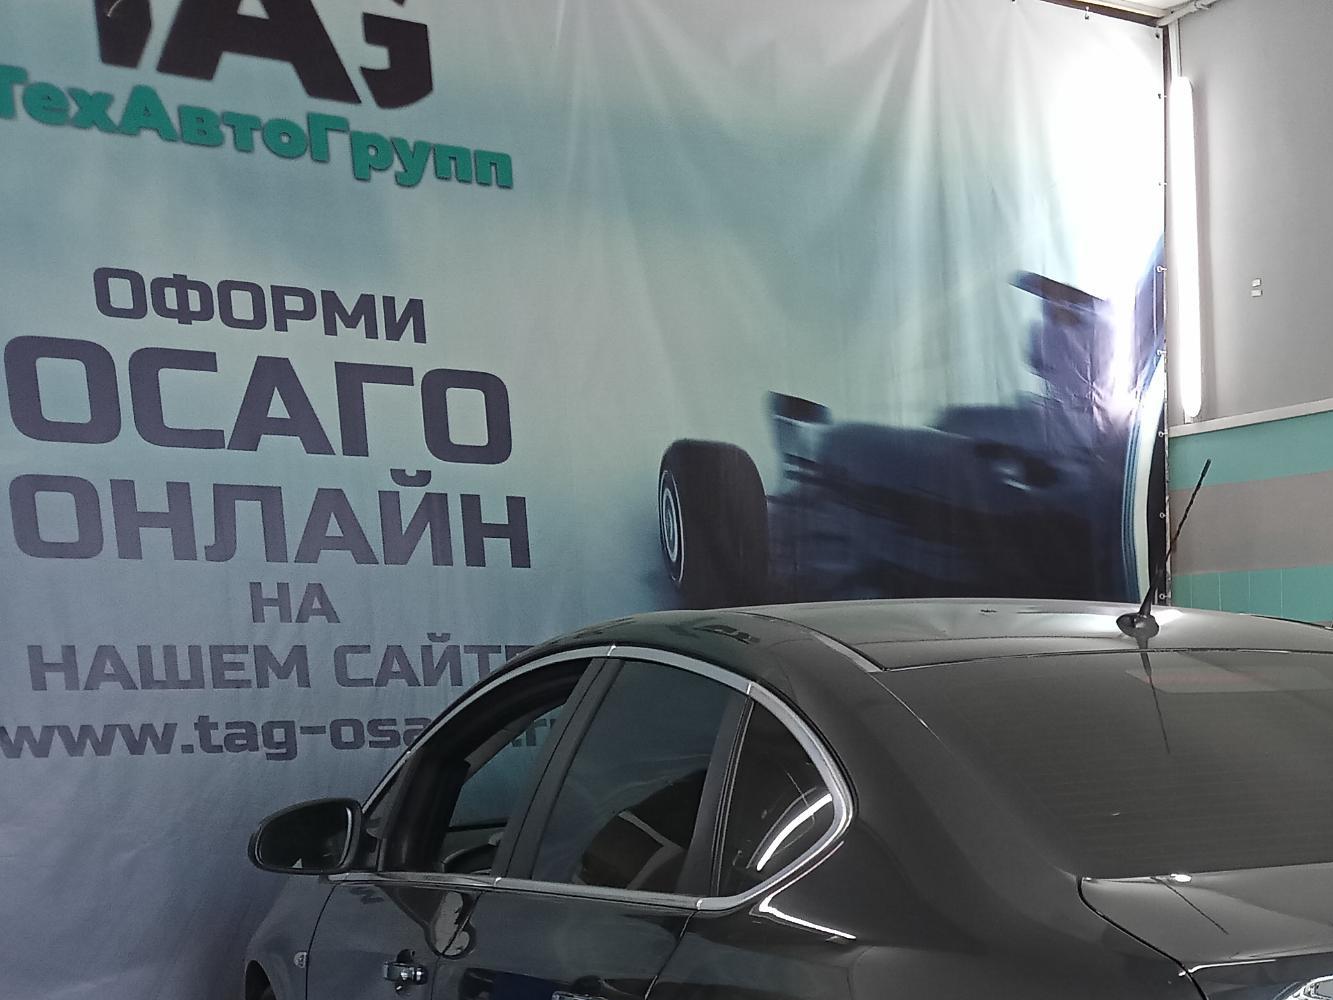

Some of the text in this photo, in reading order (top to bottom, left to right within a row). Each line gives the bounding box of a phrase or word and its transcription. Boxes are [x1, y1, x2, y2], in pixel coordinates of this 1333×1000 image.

[93, 266, 428, 344] ОФОРМИ
[3, 335, 514, 465] ОСАГО
[9, 468, 532, 569] ОНЛАЙН
[249, 582, 341, 624] НА
[27, 644, 311, 691] НАШЕМ
